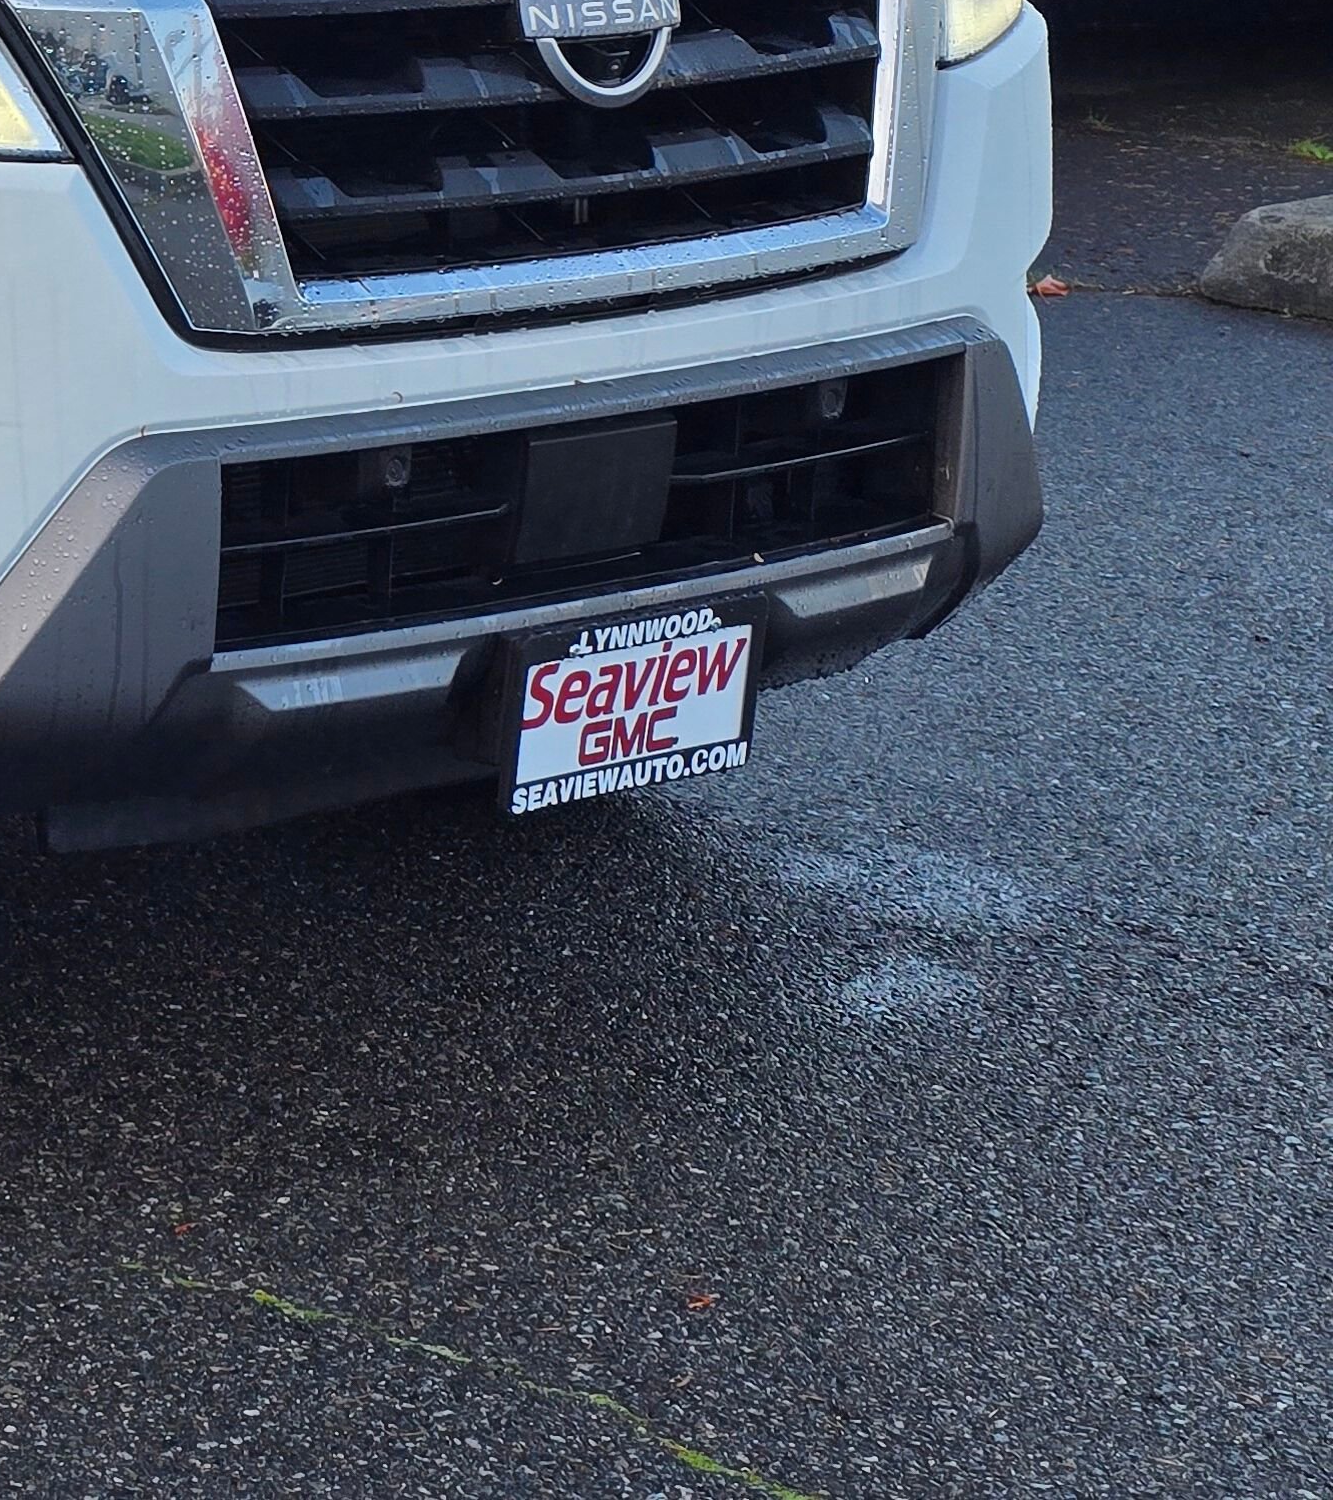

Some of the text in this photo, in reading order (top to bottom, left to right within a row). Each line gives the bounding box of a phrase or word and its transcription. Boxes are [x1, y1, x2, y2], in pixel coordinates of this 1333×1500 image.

[579, 607, 713, 656] LYNNWOOD
[521, 637, 748, 731] Seaview
[578, 705, 678, 767] GMC
[511, 741, 748, 815] SEAVIEWAUTO.COM
